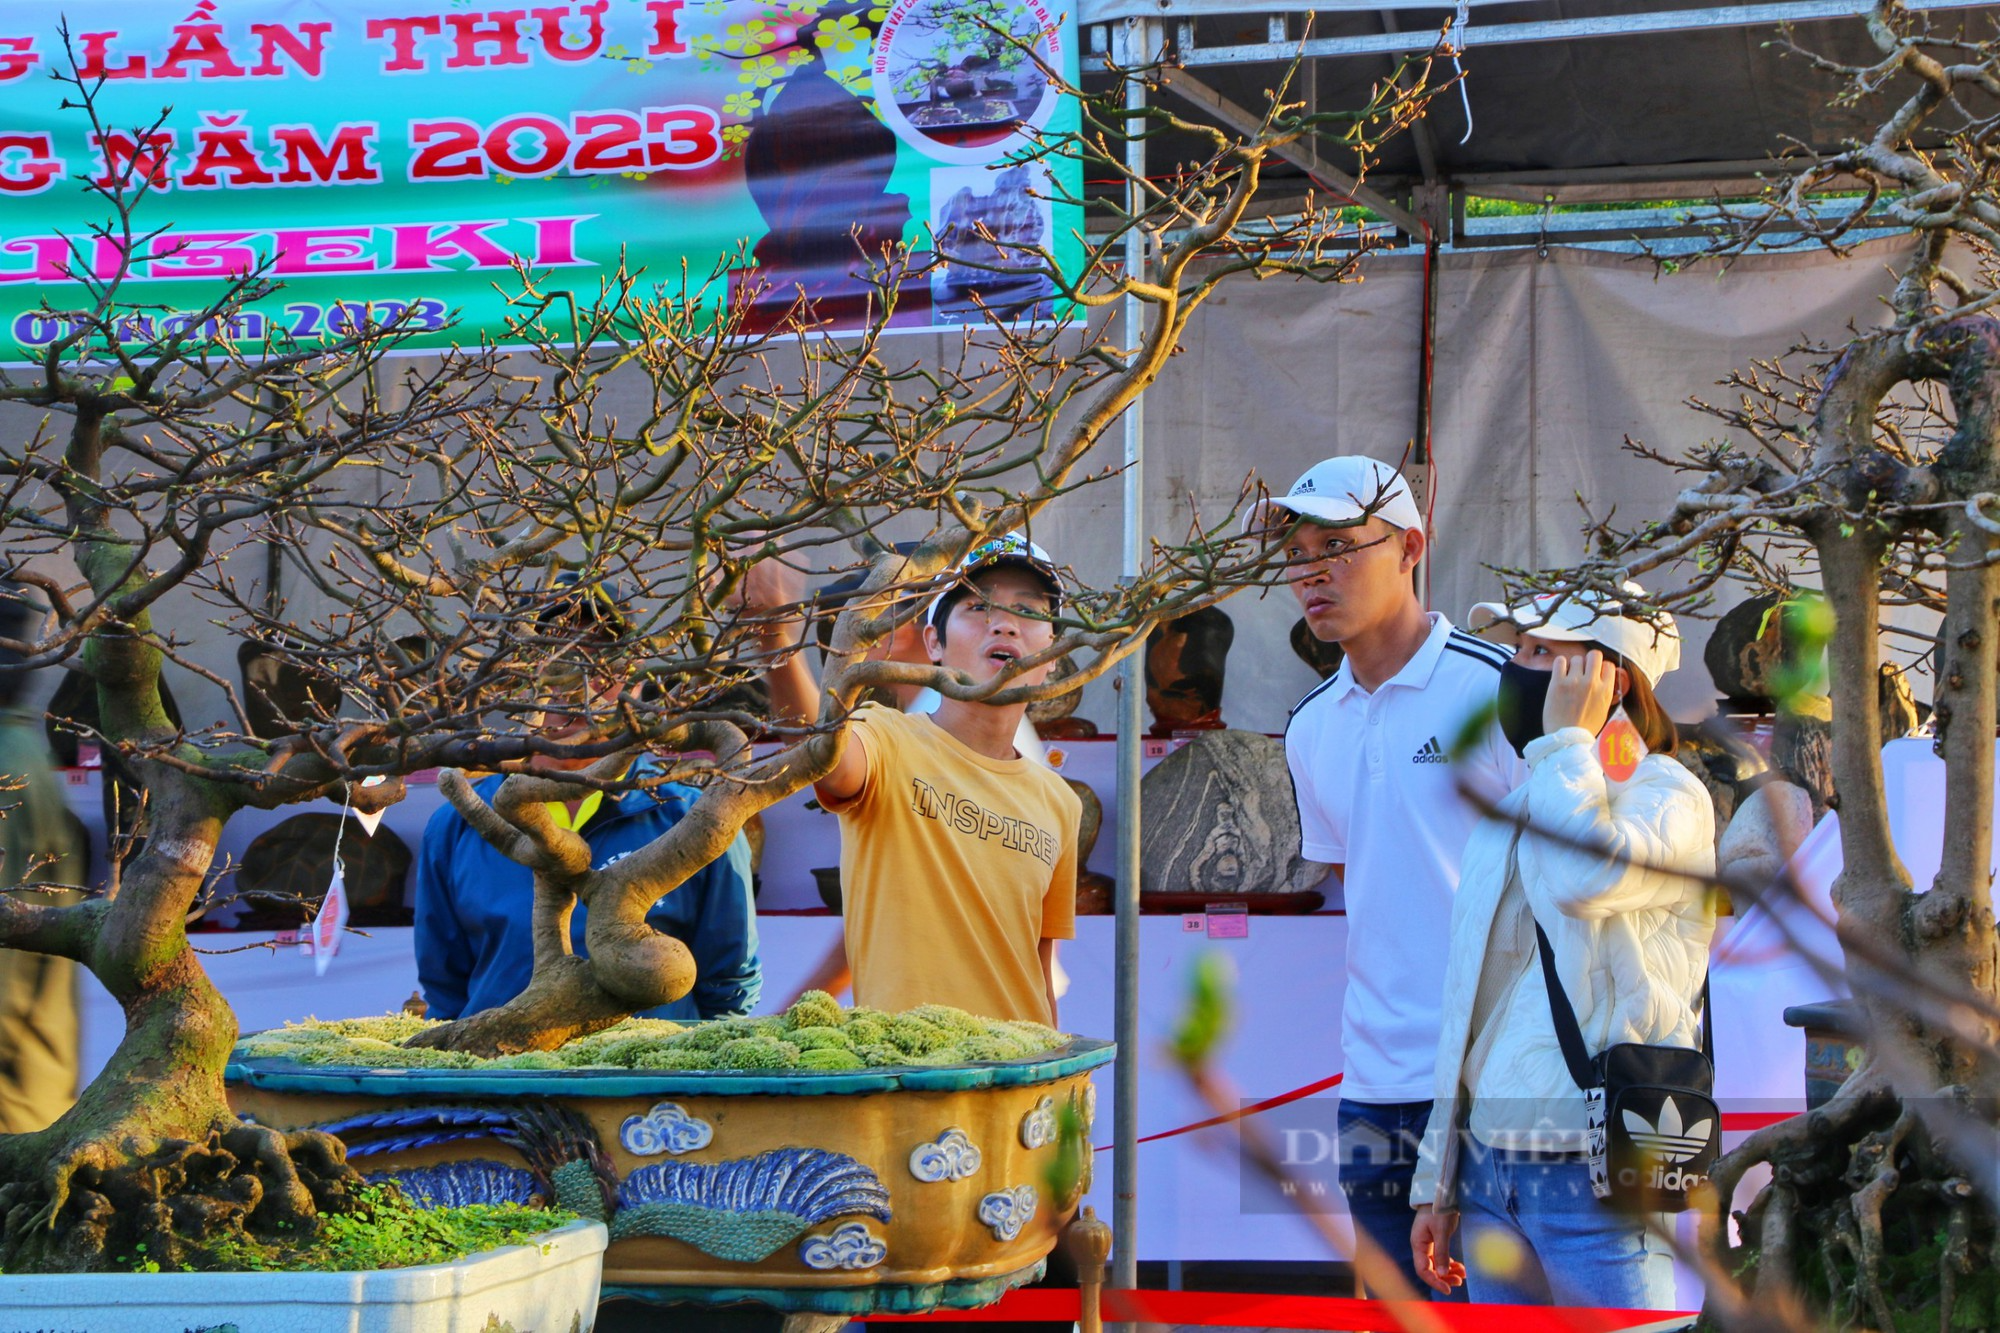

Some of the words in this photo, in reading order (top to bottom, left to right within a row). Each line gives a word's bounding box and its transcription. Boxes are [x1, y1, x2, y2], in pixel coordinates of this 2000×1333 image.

[78, 0, 332, 80] LẦN
[646, 1, 686, 54] I
[879, 27, 895, 52] SINH
[92, 115, 377, 189] NĂM
[413, 112, 718, 178] 2023
[287, 301, 447, 338] 2023
[1412, 753, 1449, 764] adidas
[1604, 733, 1634, 767] 18
[1186, 921, 1200, 929] 38
